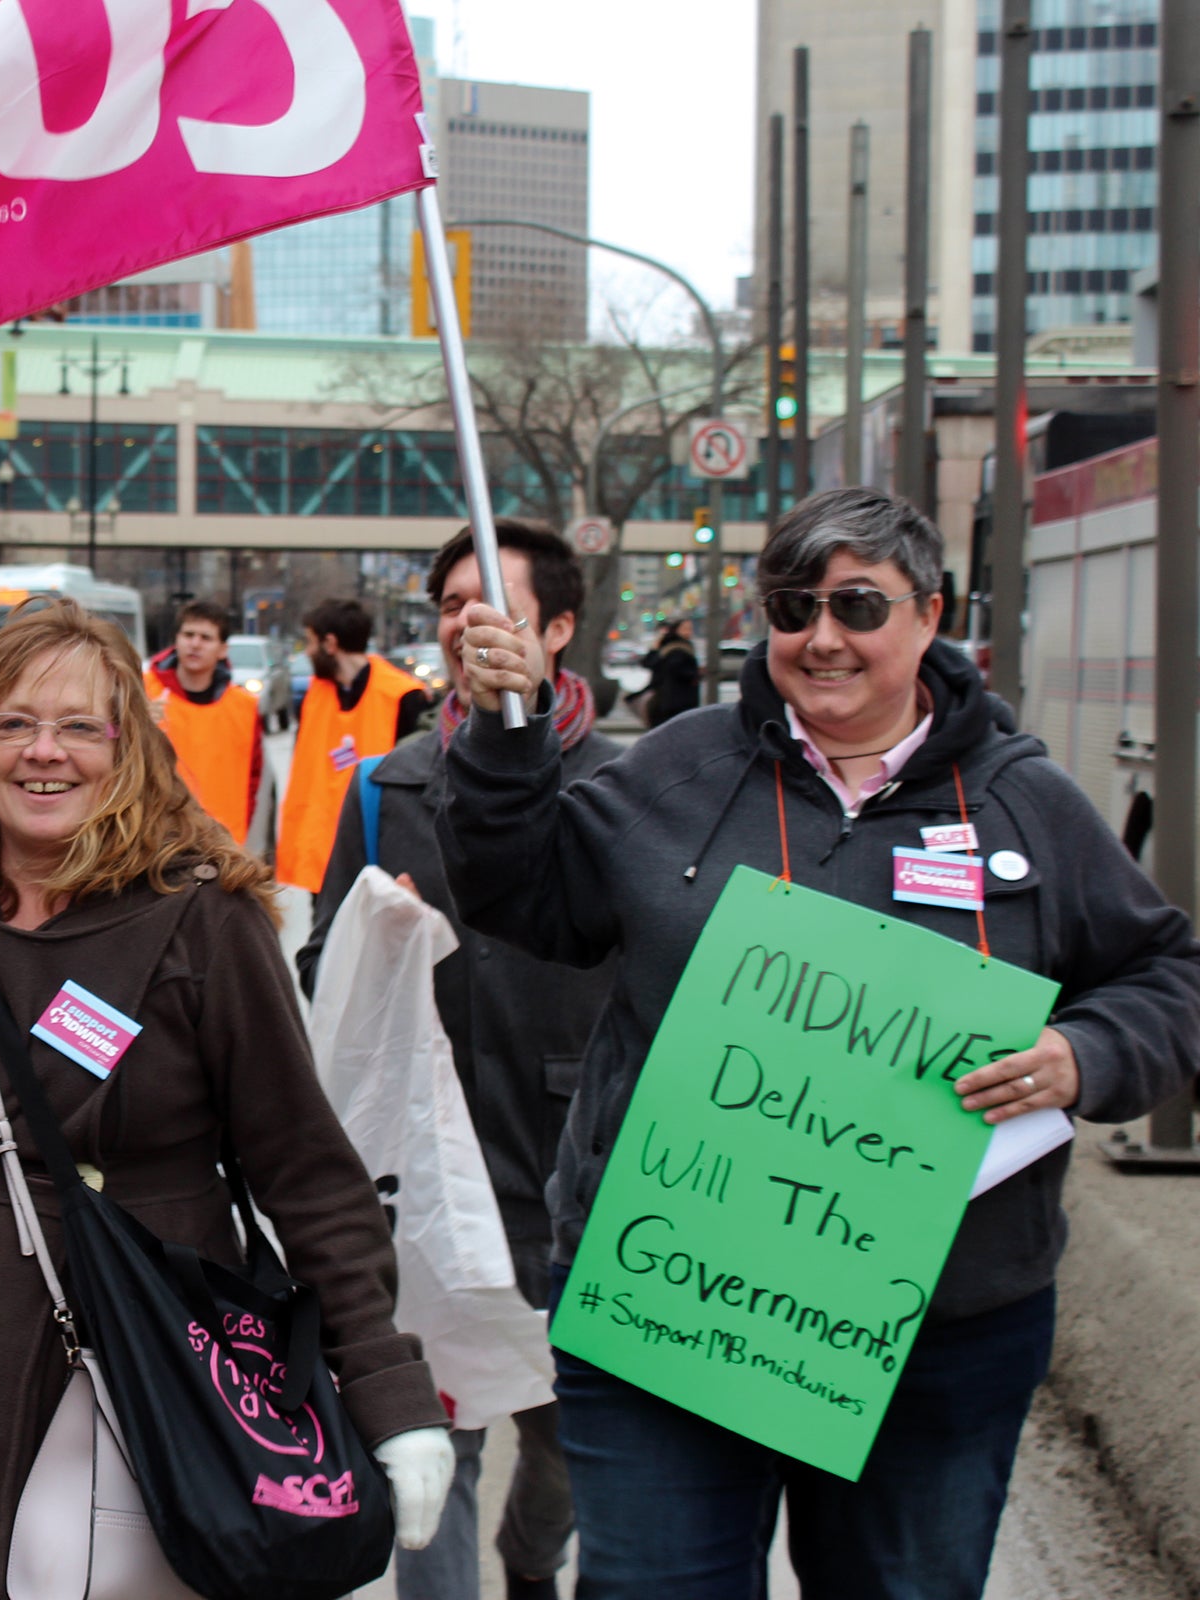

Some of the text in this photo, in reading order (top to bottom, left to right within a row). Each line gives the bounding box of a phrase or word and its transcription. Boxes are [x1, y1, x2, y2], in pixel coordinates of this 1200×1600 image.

[49, 1007, 120, 1057] MIDWIVES
[67, 1005, 118, 1040] support
[640, 1121, 876, 1252] Will The
